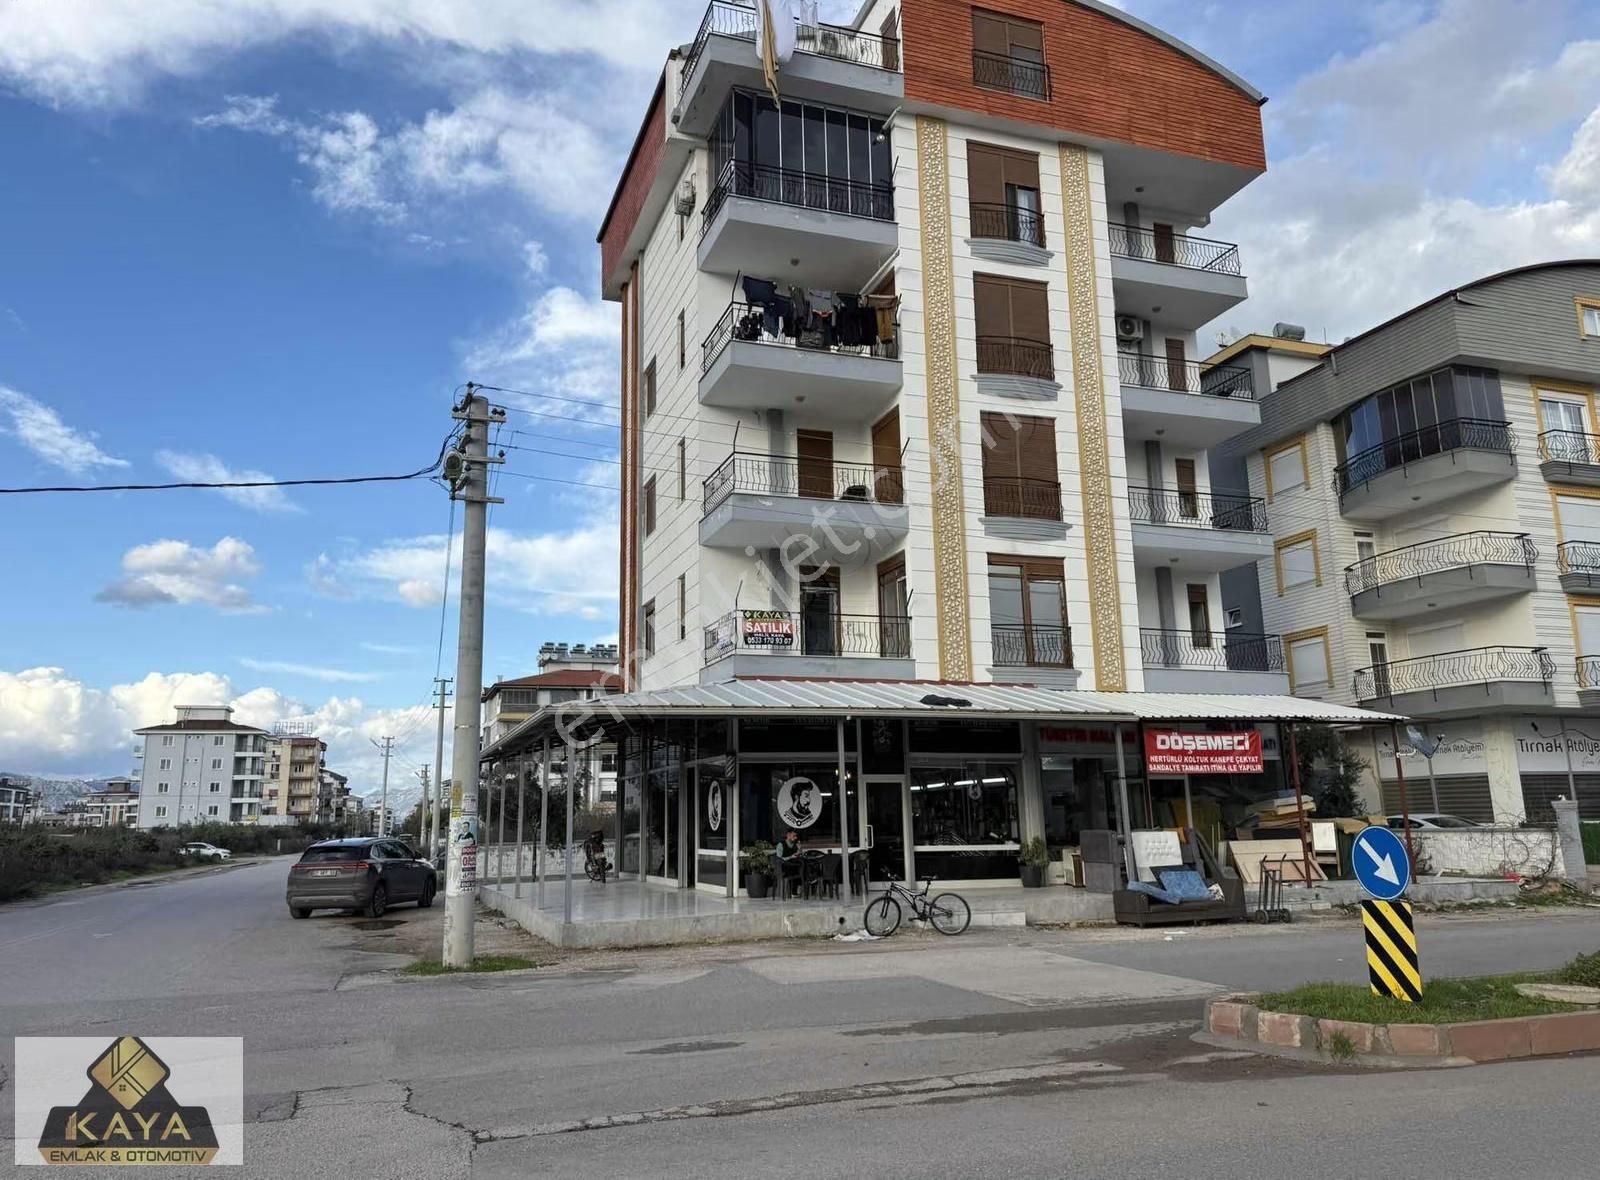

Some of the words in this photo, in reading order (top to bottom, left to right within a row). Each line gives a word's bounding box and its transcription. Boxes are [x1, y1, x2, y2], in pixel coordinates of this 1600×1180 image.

[753, 611, 781, 619] KAYA
[746, 621, 791, 634] SATILIK
[1156, 732, 1250, 755] DÖŞEMECİ
[1184, 755, 1209, 763] KOLTUK
